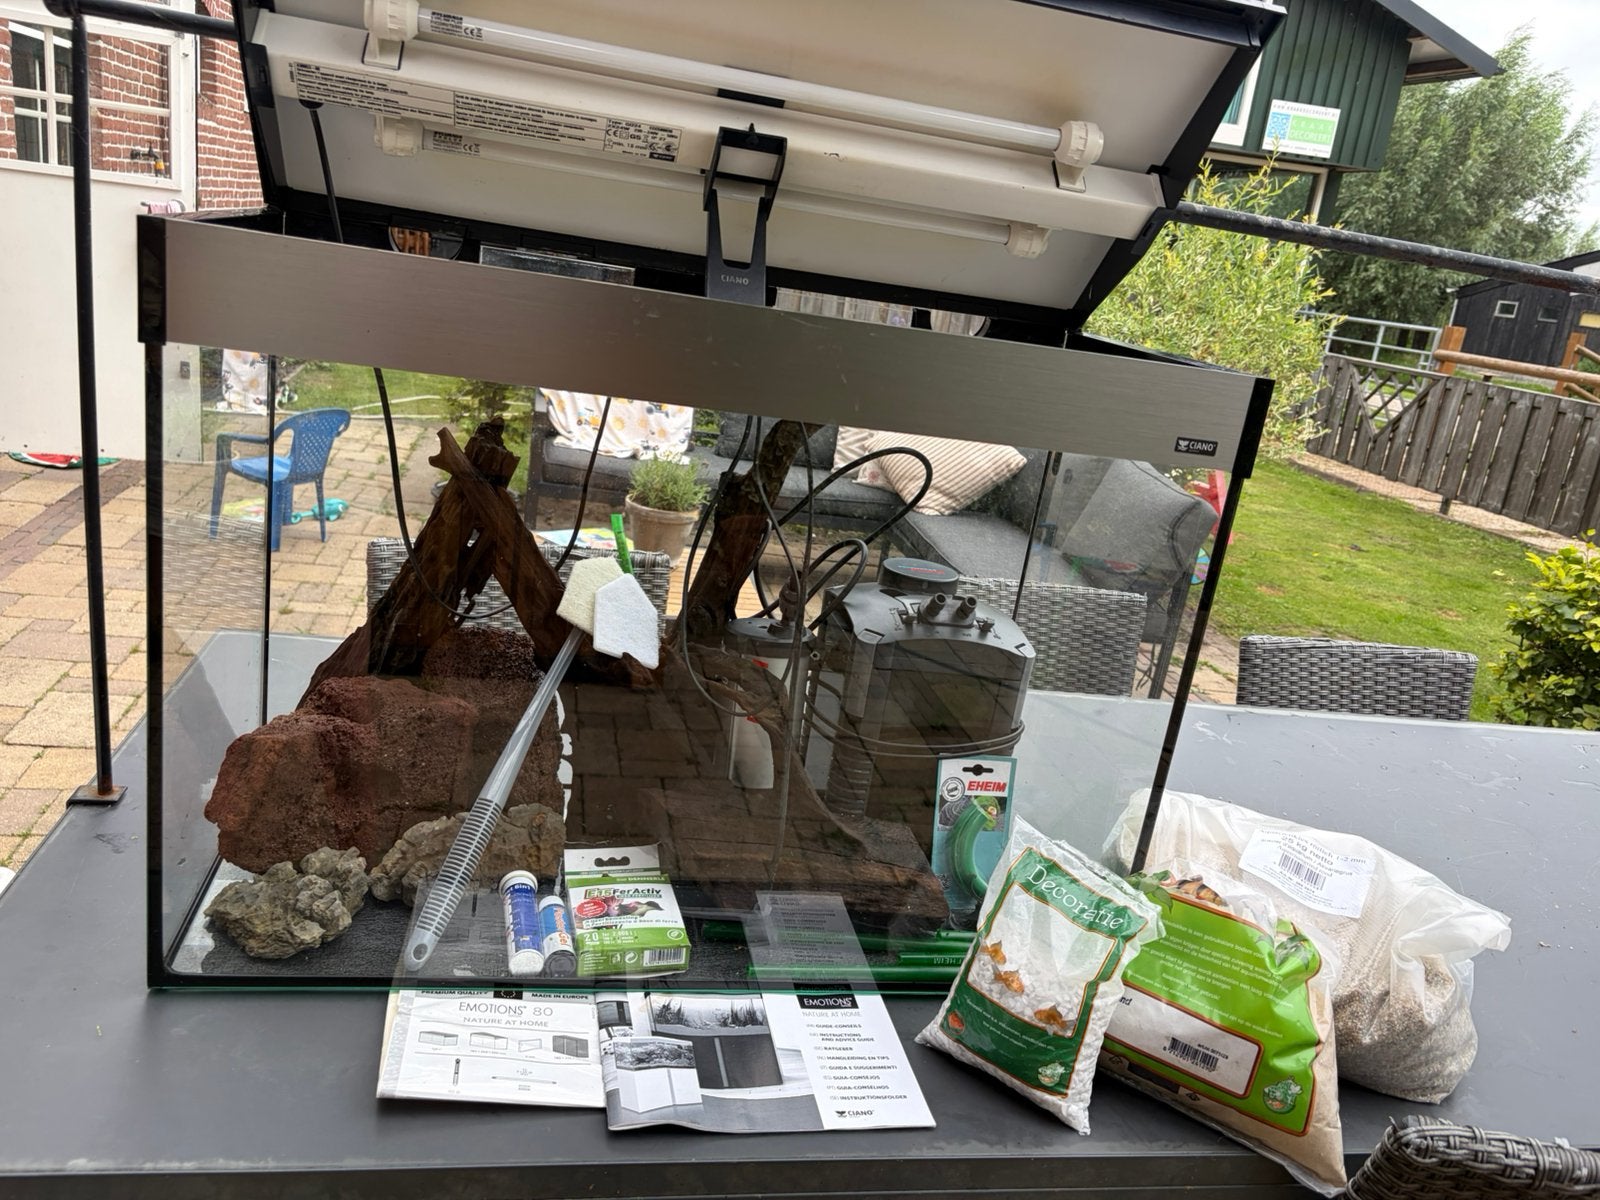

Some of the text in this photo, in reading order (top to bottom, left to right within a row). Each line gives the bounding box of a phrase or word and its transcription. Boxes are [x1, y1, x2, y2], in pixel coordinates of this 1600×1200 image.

[721, 274, 749, 286] CIANO
[1189, 441, 1214, 452] CIANO
[966, 780, 1007, 793] EHEIM
[1281, 835, 1334, 866] 25 kg netto
[613, 887, 662, 895] FerActiv
[1027, 863, 1124, 930] Decoratie
[584, 932, 599, 942] 20
[803, 998, 852, 1008] EMOTIONS
[459, 1001, 554, 1017] EMOTIONS 80
[463, 1016, 549, 1027] NATURE AT HOME
